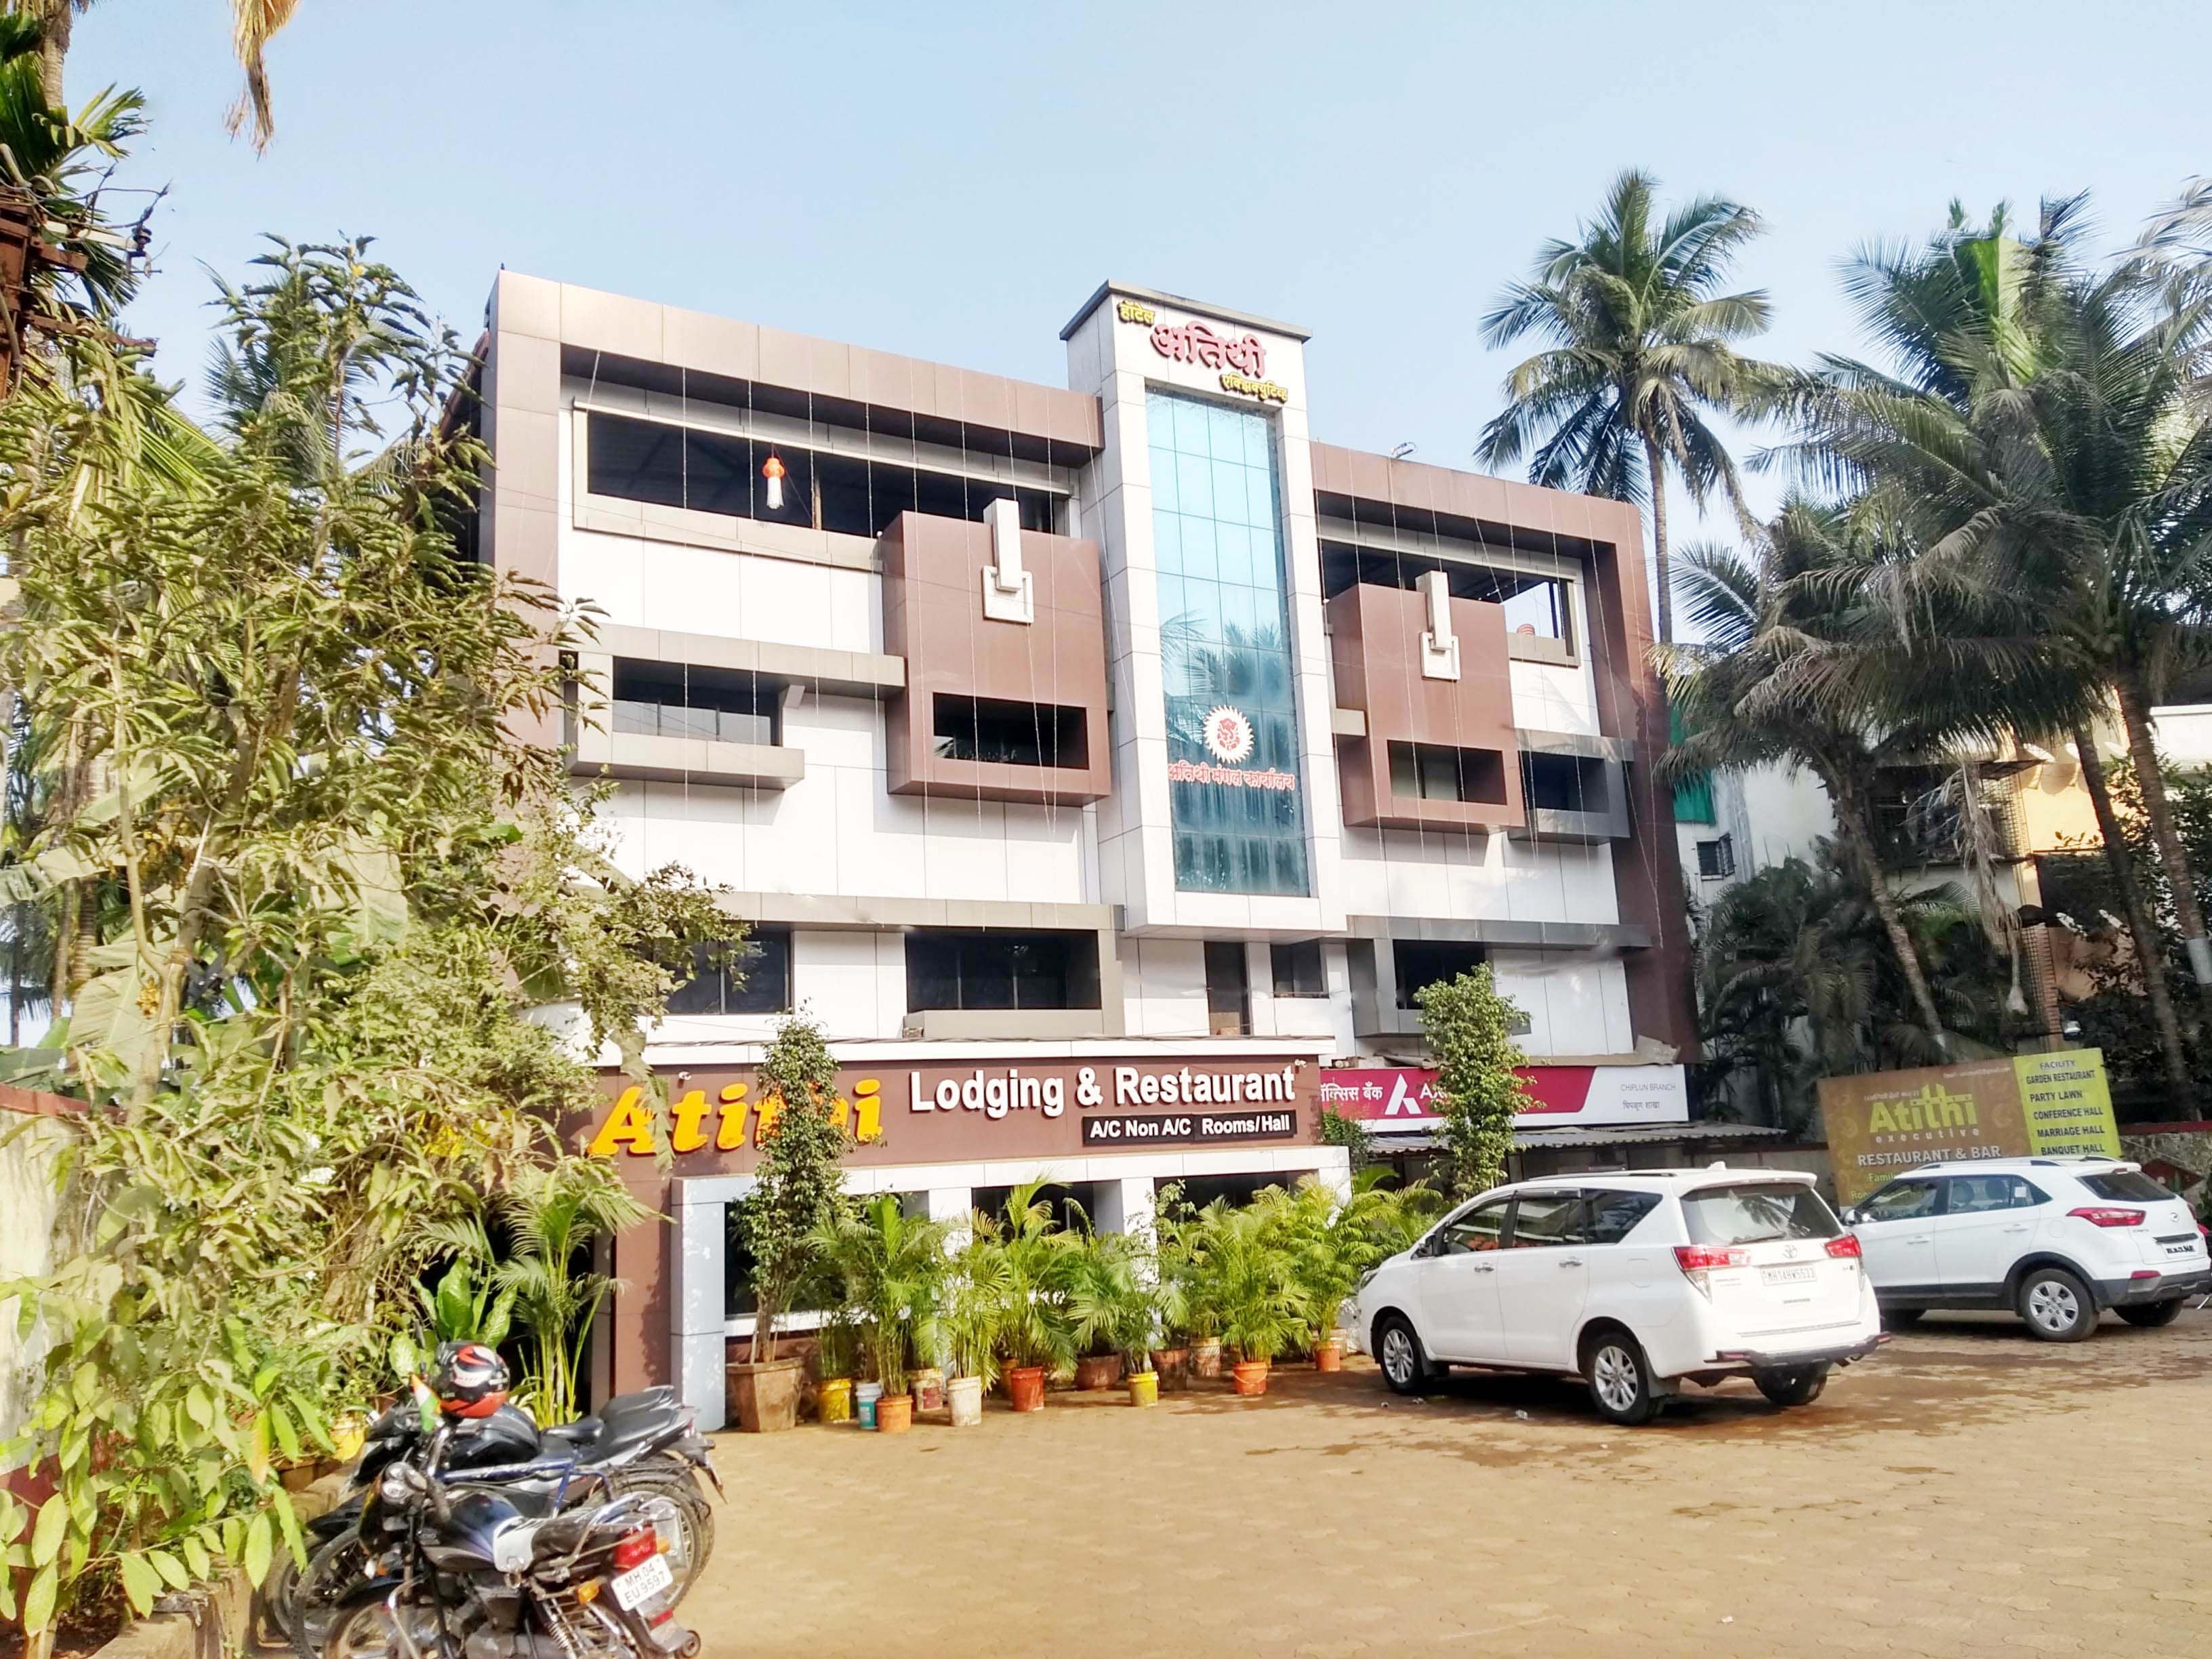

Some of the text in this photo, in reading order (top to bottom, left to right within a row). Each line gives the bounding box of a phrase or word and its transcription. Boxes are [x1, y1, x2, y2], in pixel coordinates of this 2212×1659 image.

[1118, 300, 1155, 327] हॉटेल
[1150, 321, 1266, 377] अतिथी
[1168, 760, 1295, 790] अतिथी मंगल कार्यालय
[2039, 1060, 2075, 1069] FACILITY
[2026, 1070, 2095, 1084] GARDEN RESTAURANT
[909, 1065, 1296, 1118] Lodging & Restaurant
[1362, 1080, 1383, 1101] बँक
[2030, 1090, 2083, 1103] PARTY LAWN
[1870, 1083, 1978, 1132] Atithi
[2034, 1107, 2104, 1120] CONFERENCE HALL
[1090, 1120, 1120, 1138] A/C
[1125, 1120, 1158, 1136] Non
[1162, 1118, 1191, 1135] A/C
[1875, 1128, 1980, 1143] executive
[2037, 1125, 2105, 1138] MARRIAGE HALL
[1858, 1145, 2001, 1166] RESTAURANT & BAR
[2041, 1143, 2106, 1156] BANQUET HALL
[1868, 1169, 1894, 1182] Famil
[625, 1572, 642, 1586] MH
[624, 1588, 640, 1603] EU
